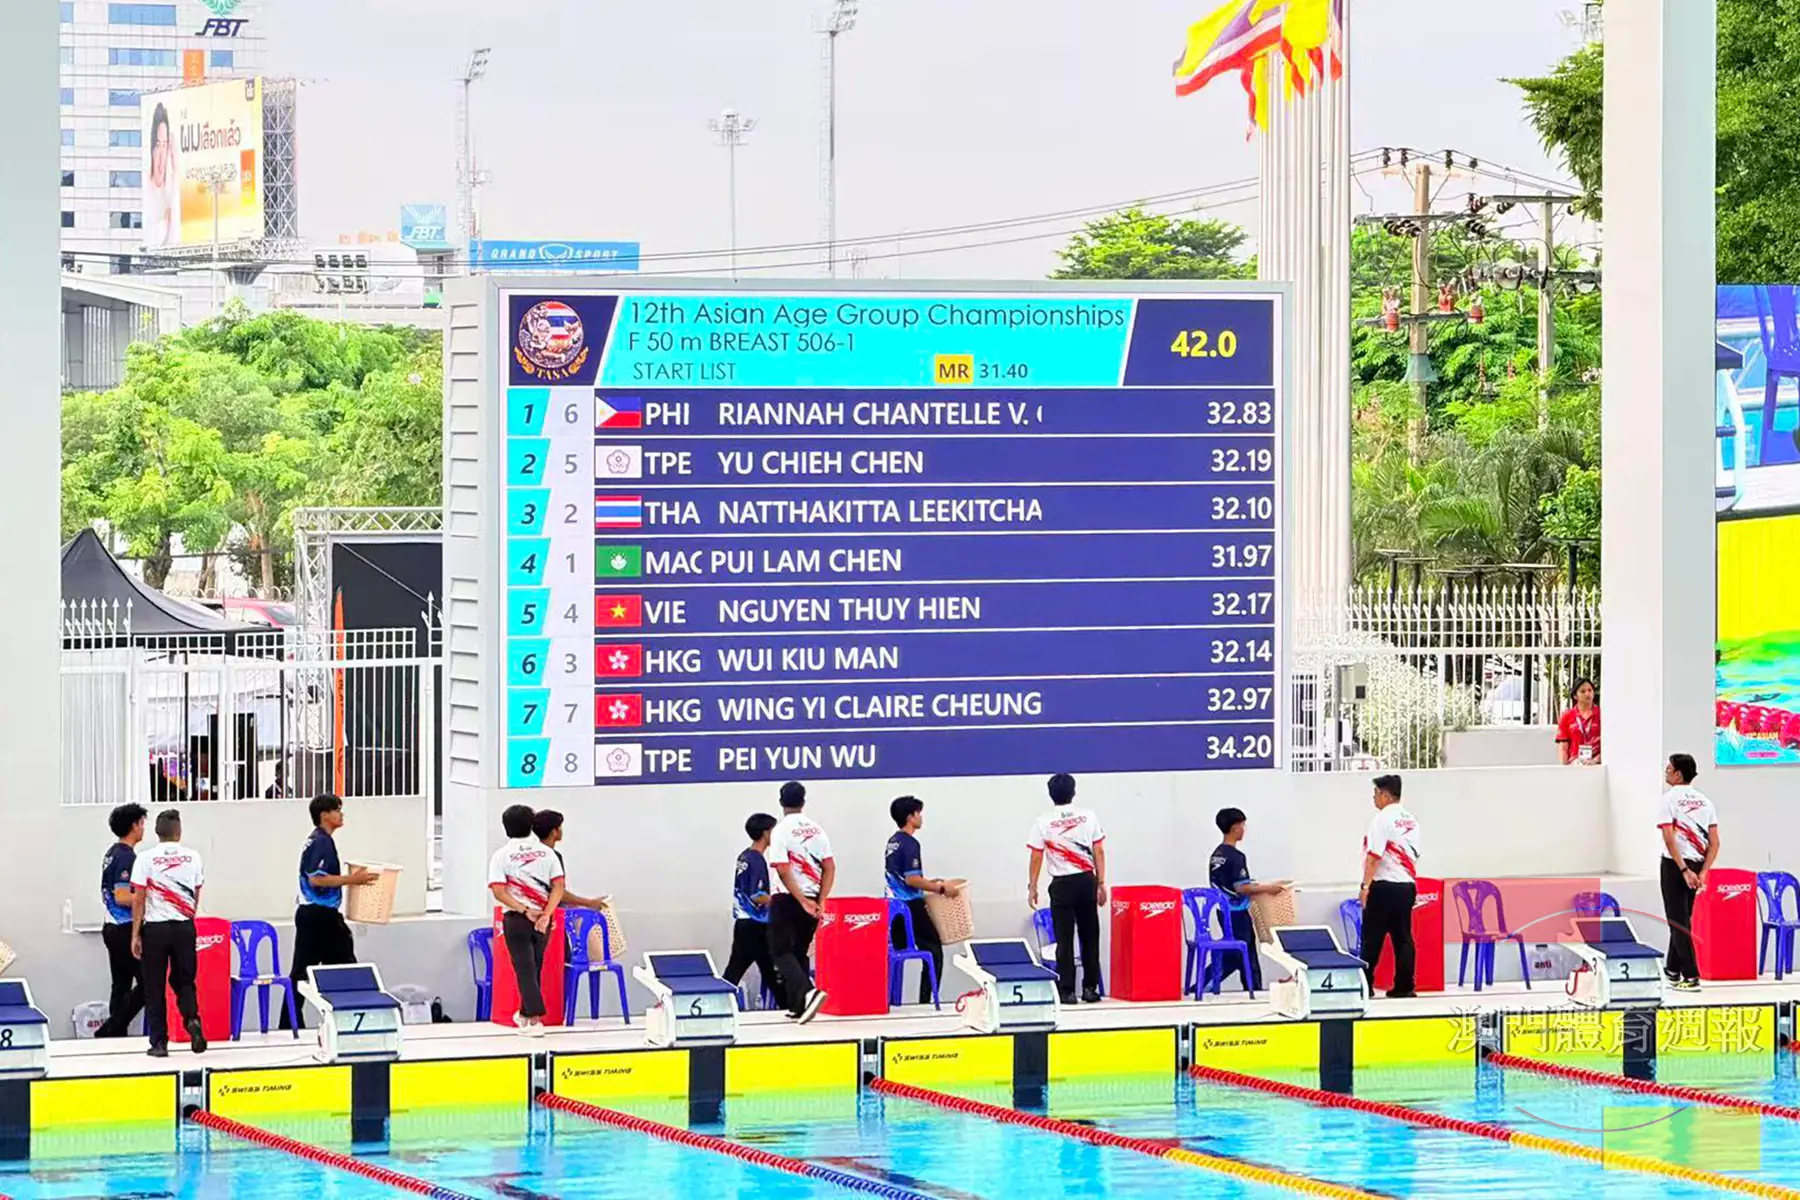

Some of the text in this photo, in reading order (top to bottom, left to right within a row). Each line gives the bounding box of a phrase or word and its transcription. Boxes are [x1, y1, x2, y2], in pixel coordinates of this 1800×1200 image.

[195, 18, 249, 37] FBT
[631, 302, 1125, 329] 12th Asian Age Group Championships
[629, 332, 855, 352] F 50 m BREAST 506-1
[1170, 330, 1237, 358] 42.0
[633, 362, 736, 380] START LIST
[939, 363, 1028, 379] MR 31.40
[524, 404, 534, 424] 1
[564, 404, 578, 424] 6
[645, 402, 690, 426] PHI
[719, 402, 844, 426] RIANNAH
[852, 401, 1001, 426] CHANTELLE
[1007, 402, 1029, 426] V.
[1206, 401, 1272, 425] 32.83
[521, 448, 1272, 475] 2 5 TPE YU CHIEH CHEN 32.19
[521, 496, 1273, 525] 3 2 THA NATTHAKITTA LEEKITCHA 32.10
[520, 544, 1273, 575] 4 1 MAC PUI LAM CHEN 31.97
[521, 592, 1273, 625] 5 4 VIE NGUYEN THUY HIEN 32.17
[522, 639, 1273, 675] 6 3 HKG WUI KIU MAN 32.14
[523, 687, 1273, 724] 7 7 HKG WING YI CLAIRE CHEUNG 32.97
[521, 734, 1272, 774] 8 8 TPE PEI YUN WU 34.20
[1050, 815, 1087, 828] speedo
[152, 855, 192, 866] speedo
[1717, 883, 1753, 894] speedo
[1139, 900, 1177, 912] speedo
[843, 912, 882, 923] speedo
[196, 934, 225, 945] eedo
[1320, 972, 1334, 990] 4
[1619, 962, 1630, 980] 3
[1012, 985, 1024, 1004] 5
[690, 996, 703, 1017] 6
[353, 1012, 366, 1033] 7
[1, 1028, 13, 1048] 8
